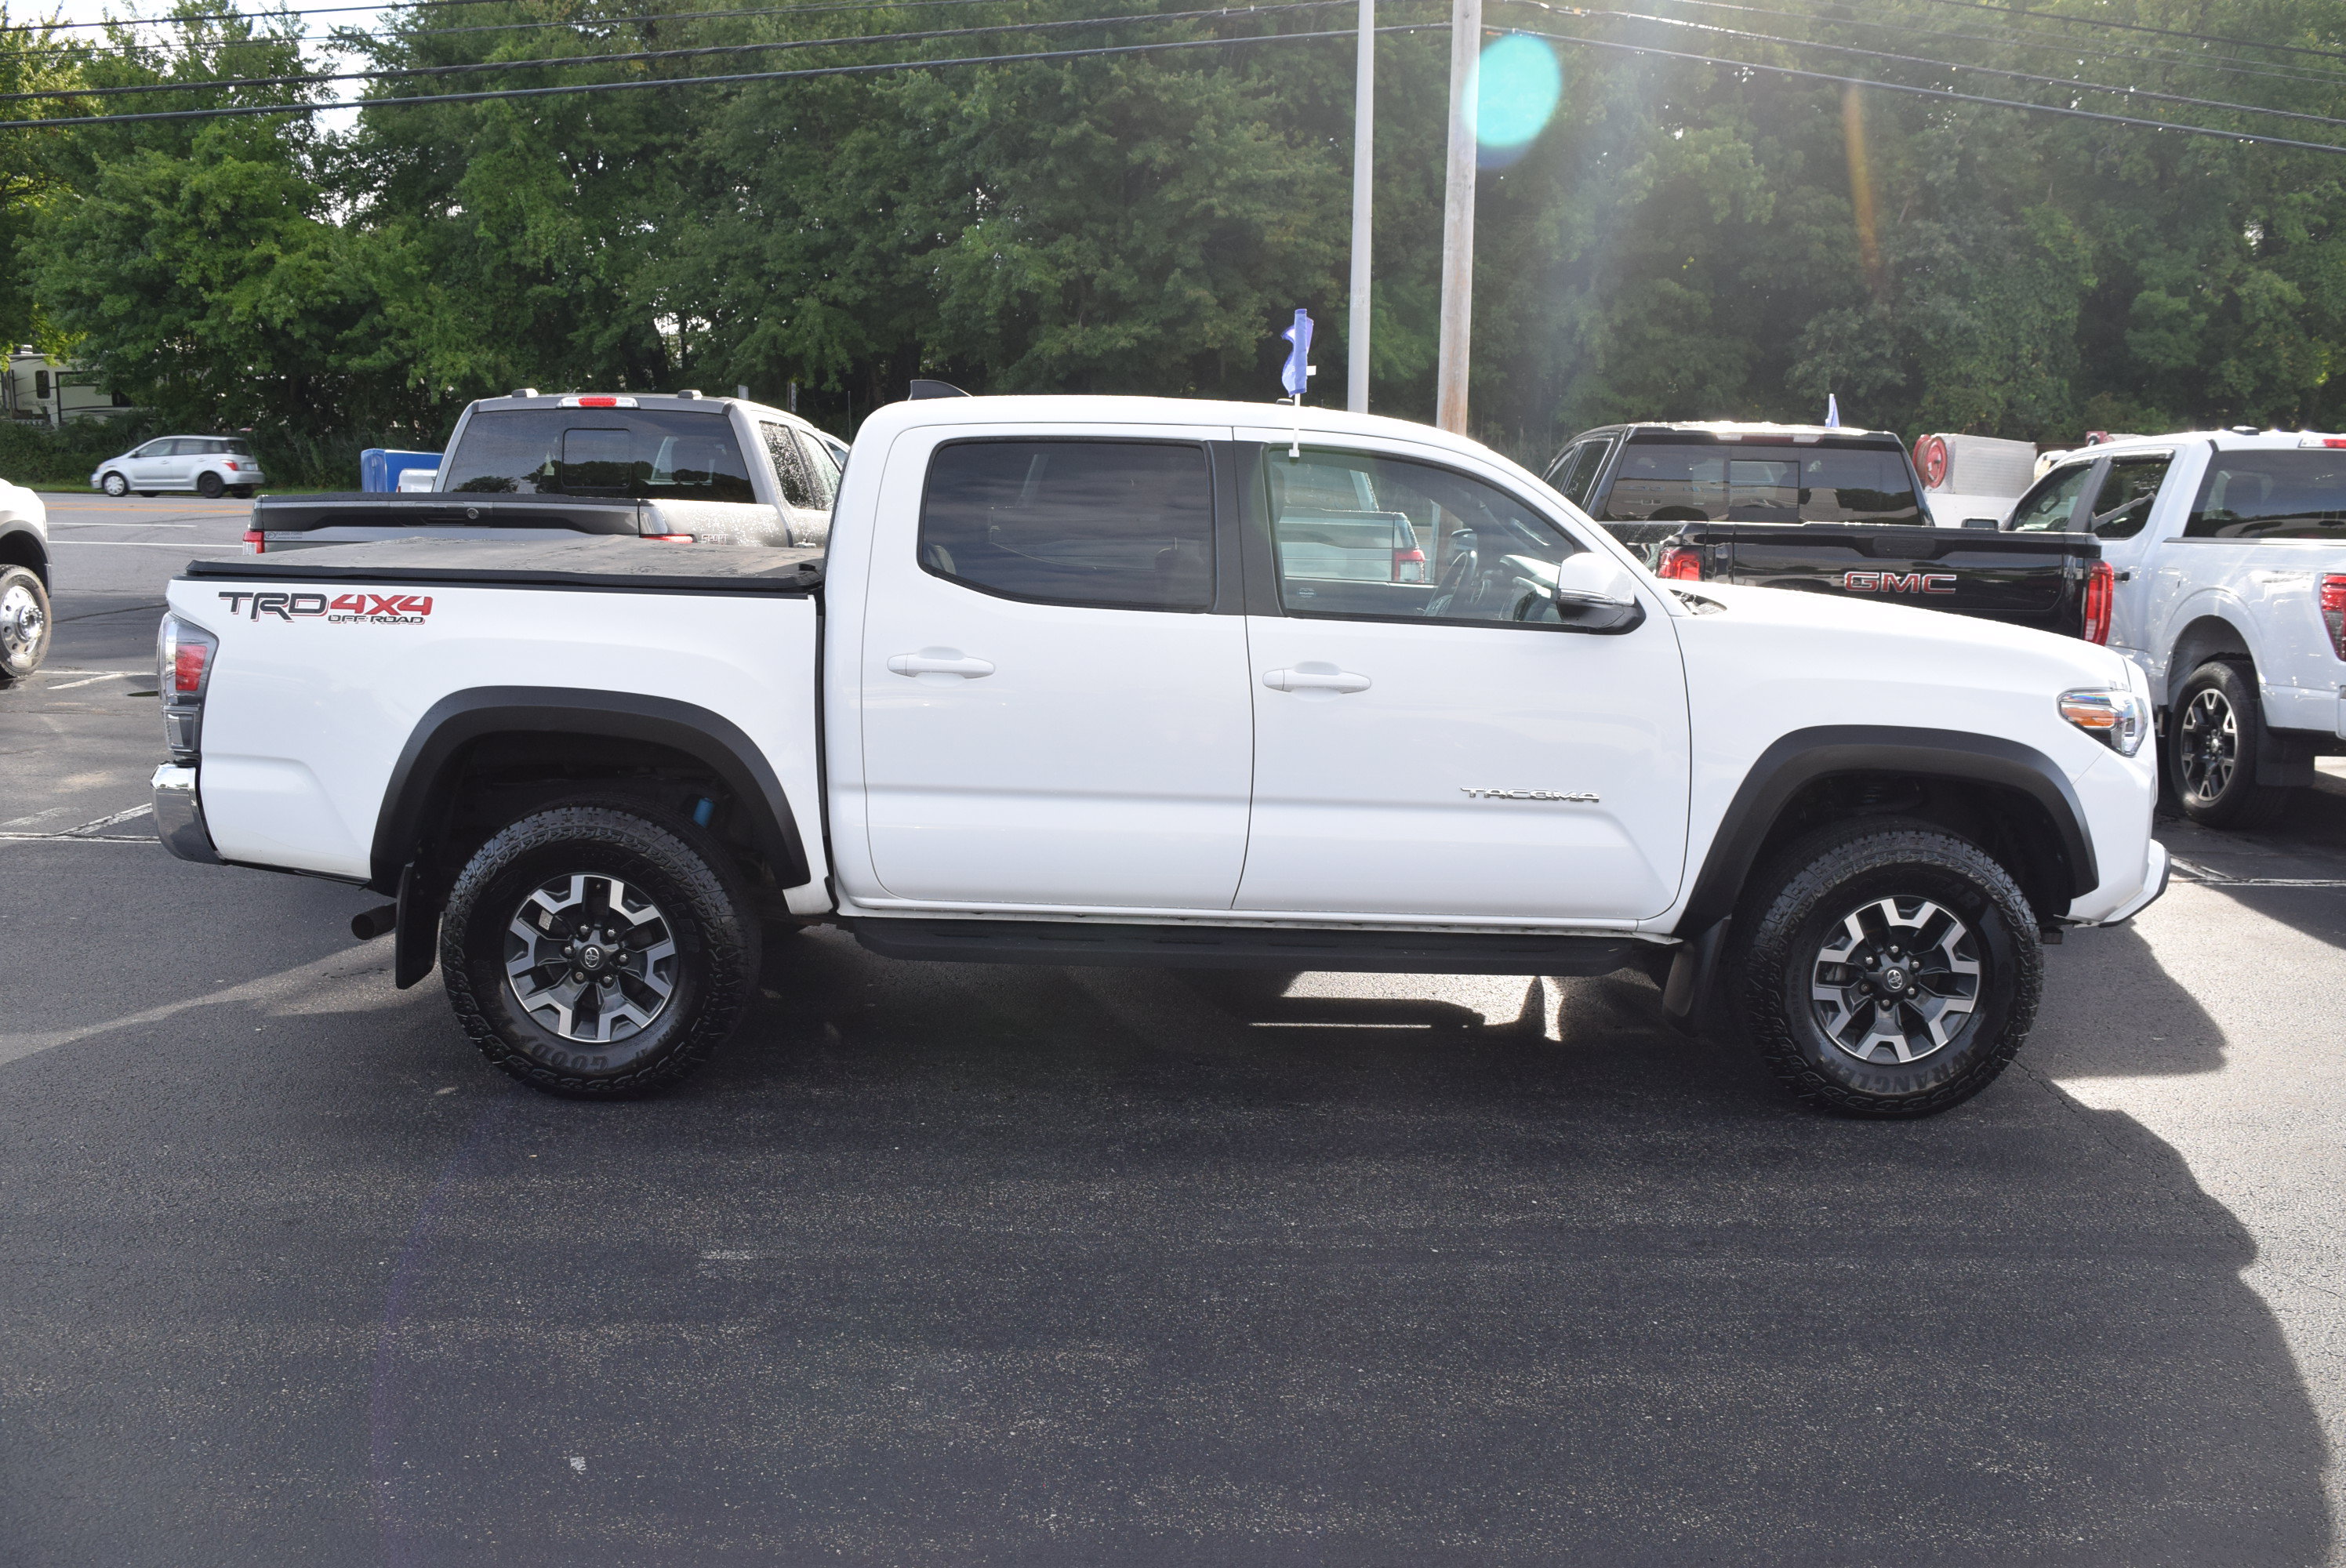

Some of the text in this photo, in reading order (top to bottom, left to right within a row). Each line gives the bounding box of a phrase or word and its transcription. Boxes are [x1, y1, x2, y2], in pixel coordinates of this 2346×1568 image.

[1844, 572, 1957, 593] GMC
[218, 591, 330, 622] TRD
[328, 614, 426, 626] OFF ROAD
[1461, 787, 1600, 803] TACOMA
